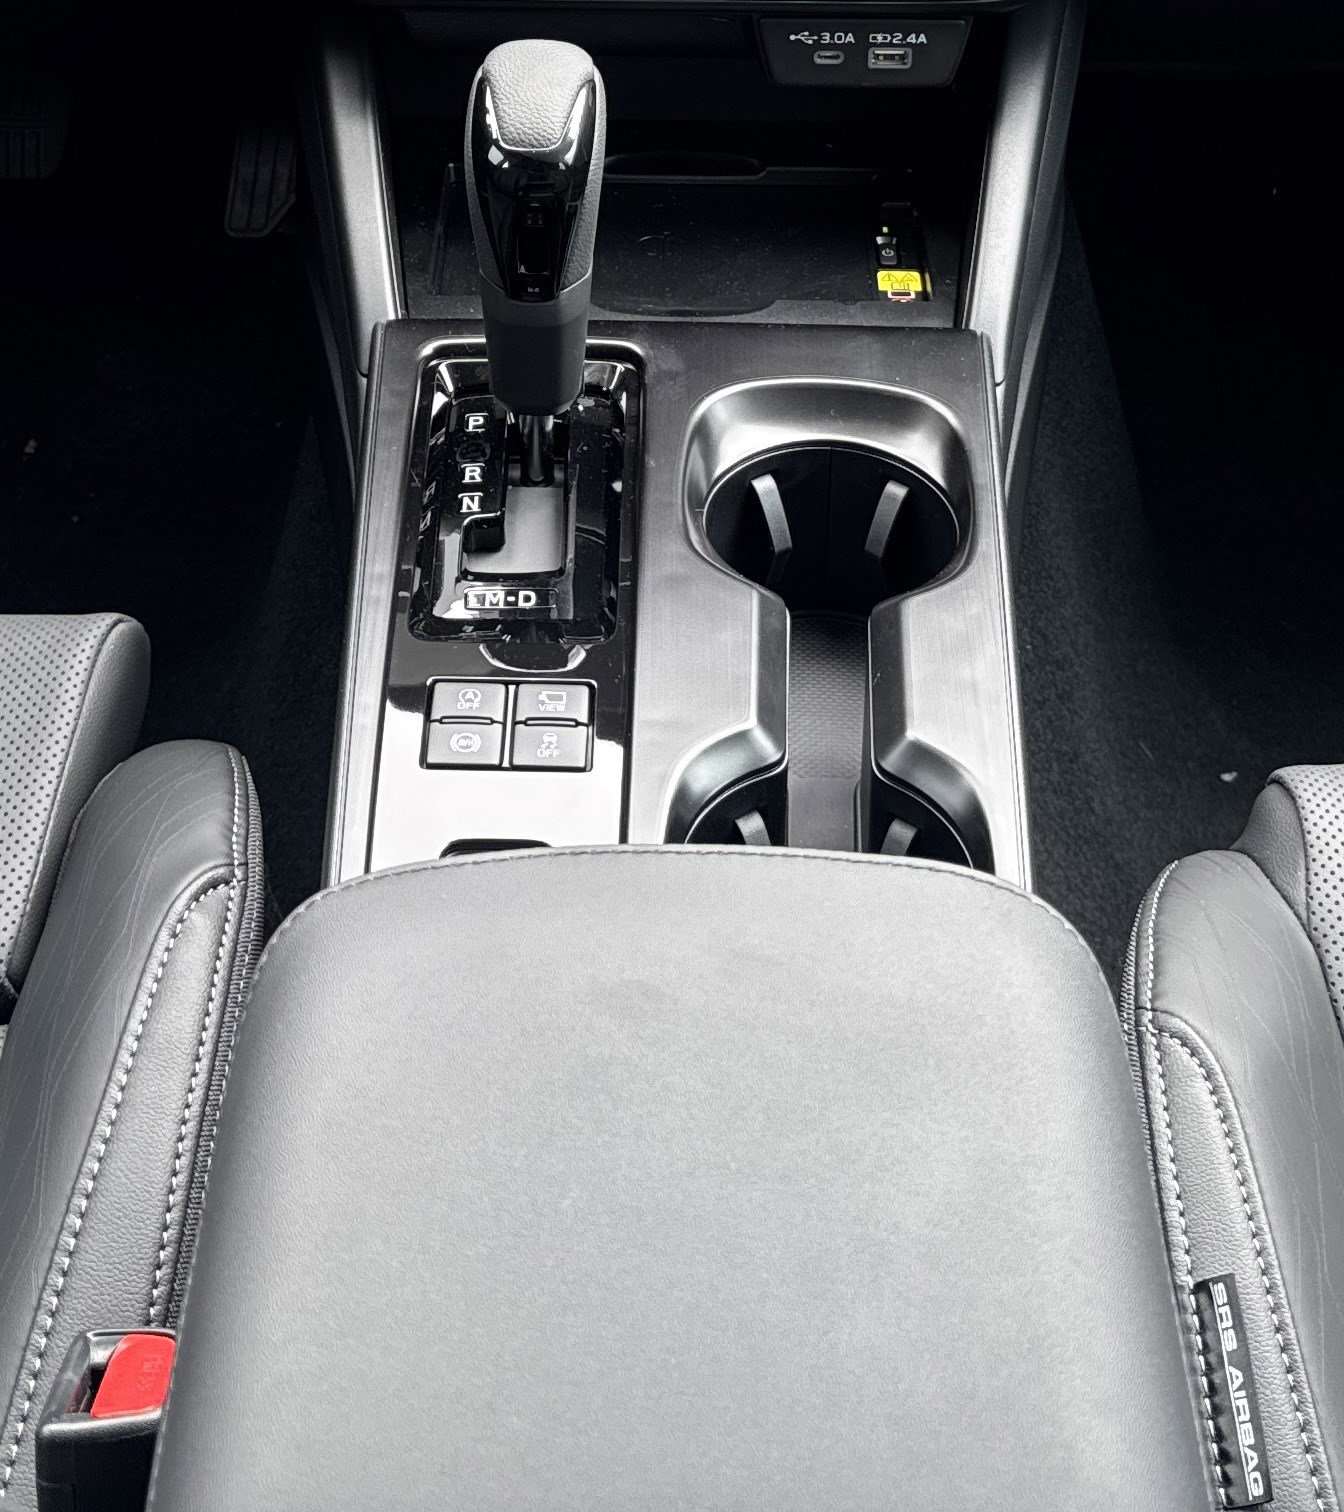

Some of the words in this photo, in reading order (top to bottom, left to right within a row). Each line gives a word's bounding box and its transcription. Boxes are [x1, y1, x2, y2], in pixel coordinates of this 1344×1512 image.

[819, 32, 855, 44] 3.0A
[892, 33, 927, 45] 2.4A
[468, 415, 484, 431] P
[463, 465, 483, 482] R
[460, 495, 481, 512] N
[456, 701, 480, 709] OFF
[538, 703, 565, 711] VIEW
[536, 749, 560, 757] OFF
[1213, 1282, 1238, 1352] SRS
[1228, 1365, 1264, 1497] AIRBAG
